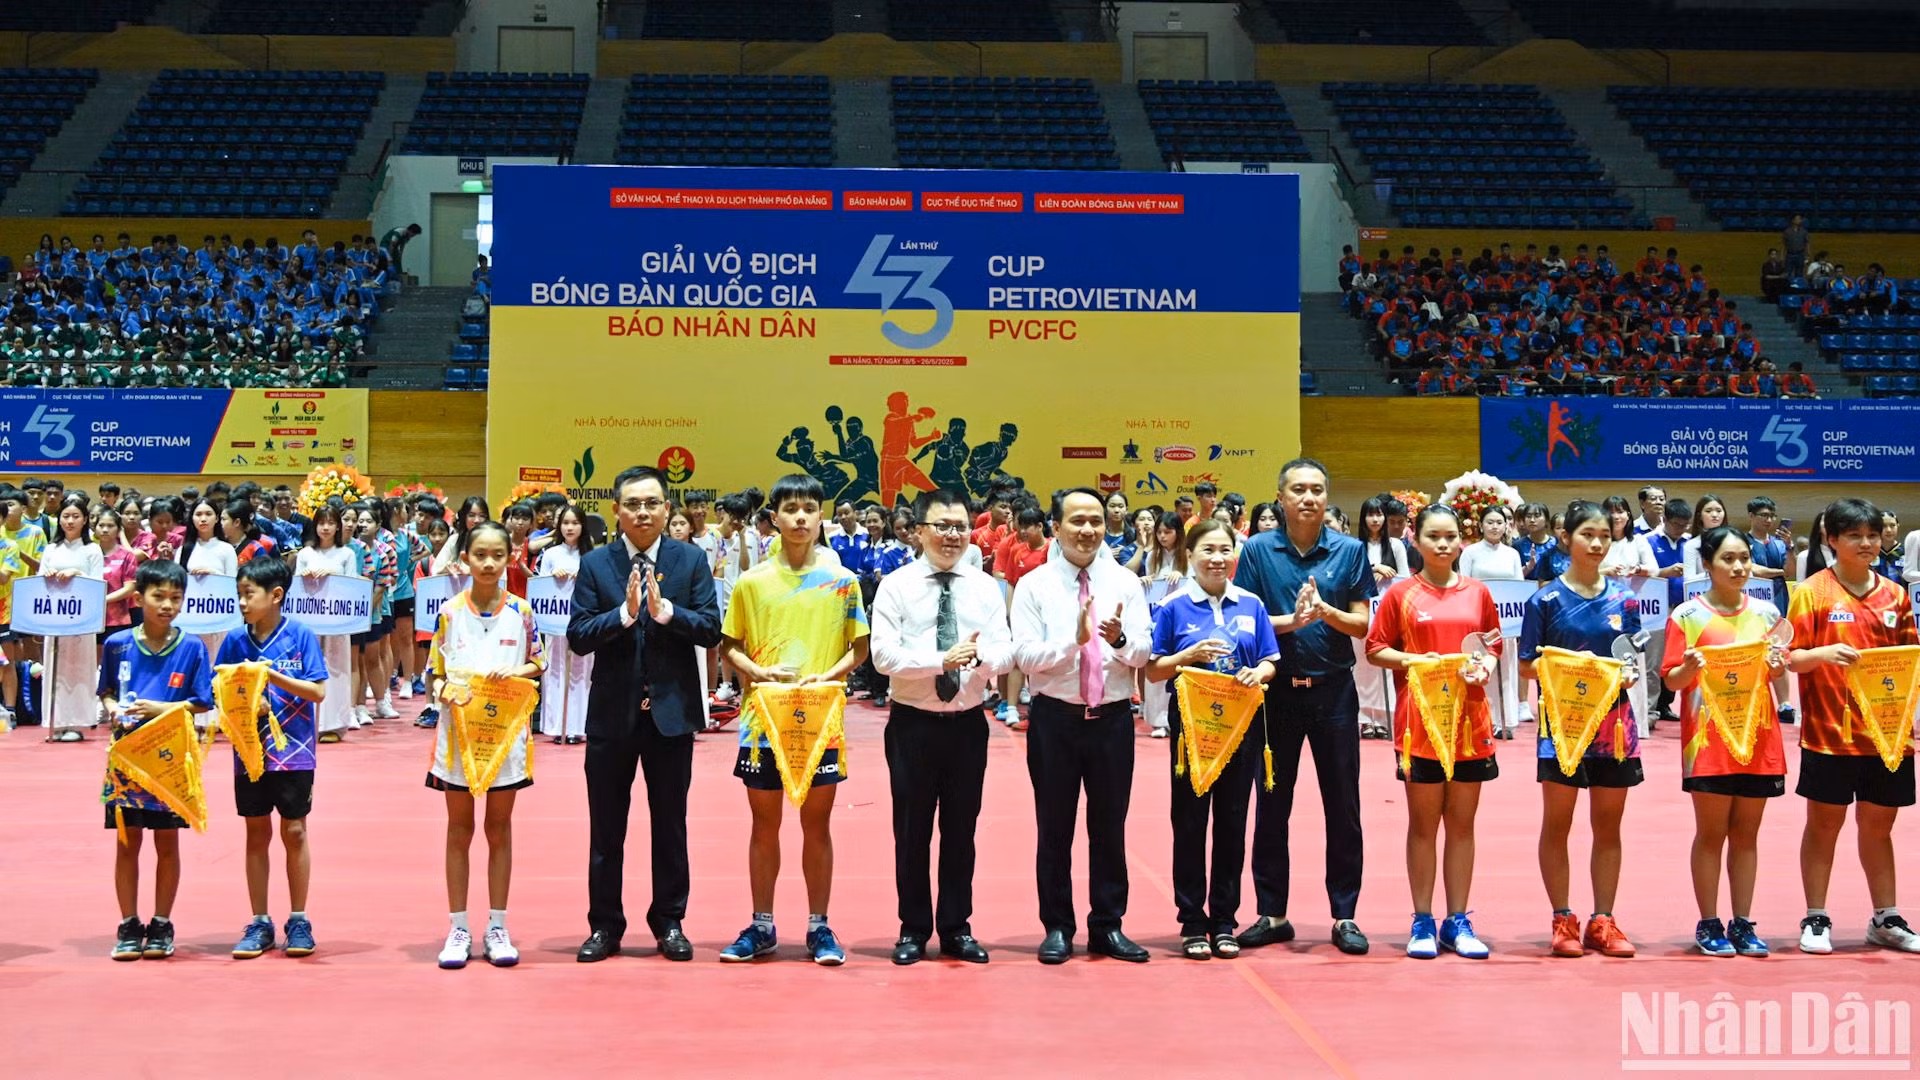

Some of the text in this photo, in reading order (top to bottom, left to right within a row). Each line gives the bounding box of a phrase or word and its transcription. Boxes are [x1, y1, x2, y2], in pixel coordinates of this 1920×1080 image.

[460, 162, 477, 170] KHU
[615, 193, 628, 203] SỞ
[628, 192, 644, 203] VĂN
[665, 192, 681, 204] THỂ
[682, 195, 705, 204] THAO
[705, 194, 715, 204] VÀ
[716, 195, 728, 204] DU
[729, 195, 746, 206] LỊCH
[748, 194, 773, 205] THÀNH
[775, 194, 792, 205] PHỐ
[792, 194, 804, 205] ĐÀ
[849, 195, 907, 207] BÁO NHÂN DÂN
[926, 196, 1018, 209] CỤC THỂ DỤC THỂ THAO
[1039, 198, 1178, 210] LIÊN ĐOÀN BÓNG BÀN VIỆT NAM
[900, 240, 939, 250] LẦN THỨ
[641, 244, 817, 280] GIẢI VÔ ĐỊCH
[988, 255, 1045, 278] CUP
[531, 274, 818, 308] BÓNG BÀN QUỐC GIA
[843, 234, 955, 350] 43
[988, 287, 1197, 310] PETROVIETNAM
[608, 310, 817, 338] BÁO NHÂN DÂN
[988, 319, 1078, 341] PVCFC
[91, 421, 119, 433] CUP
[574, 416, 698, 428] NHÀ ĐỒNG HÀNH CHÍNH
[1125, 419, 1191, 430] NHÀ TÀI TRỢ
[22, 404, 76, 459] 43
[1670, 426, 1749, 443] GIẢI VÔ ĐỊCH
[1822, 431, 1848, 442] CUP
[91, 435, 191, 447] PETROVIETNAM
[1759, 414, 1809, 467] 43
[1224, 449, 1255, 457] VNPT
[1623, 440, 1749, 456] BÓNG BÀN QUỐC GIA
[1822, 445, 1916, 456] PETROVIETNAM
[91, 451, 134, 462] PVCFC
[1656, 455, 1749, 469] BÁO NHÂN DÂN
[1822, 459, 1863, 470] PVCFC
[566, 488, 616, 500] ROVIETNAM
[33, 594, 82, 620] HÀ NỘI
[186, 593, 236, 614] PHÒNG
[296, 597, 352, 616] DƯƠNG-LONG
[353, 594, 369, 617] HẢI
[1828, 612, 1853, 622] TAKE
[278, 661, 302, 670] TAKE
